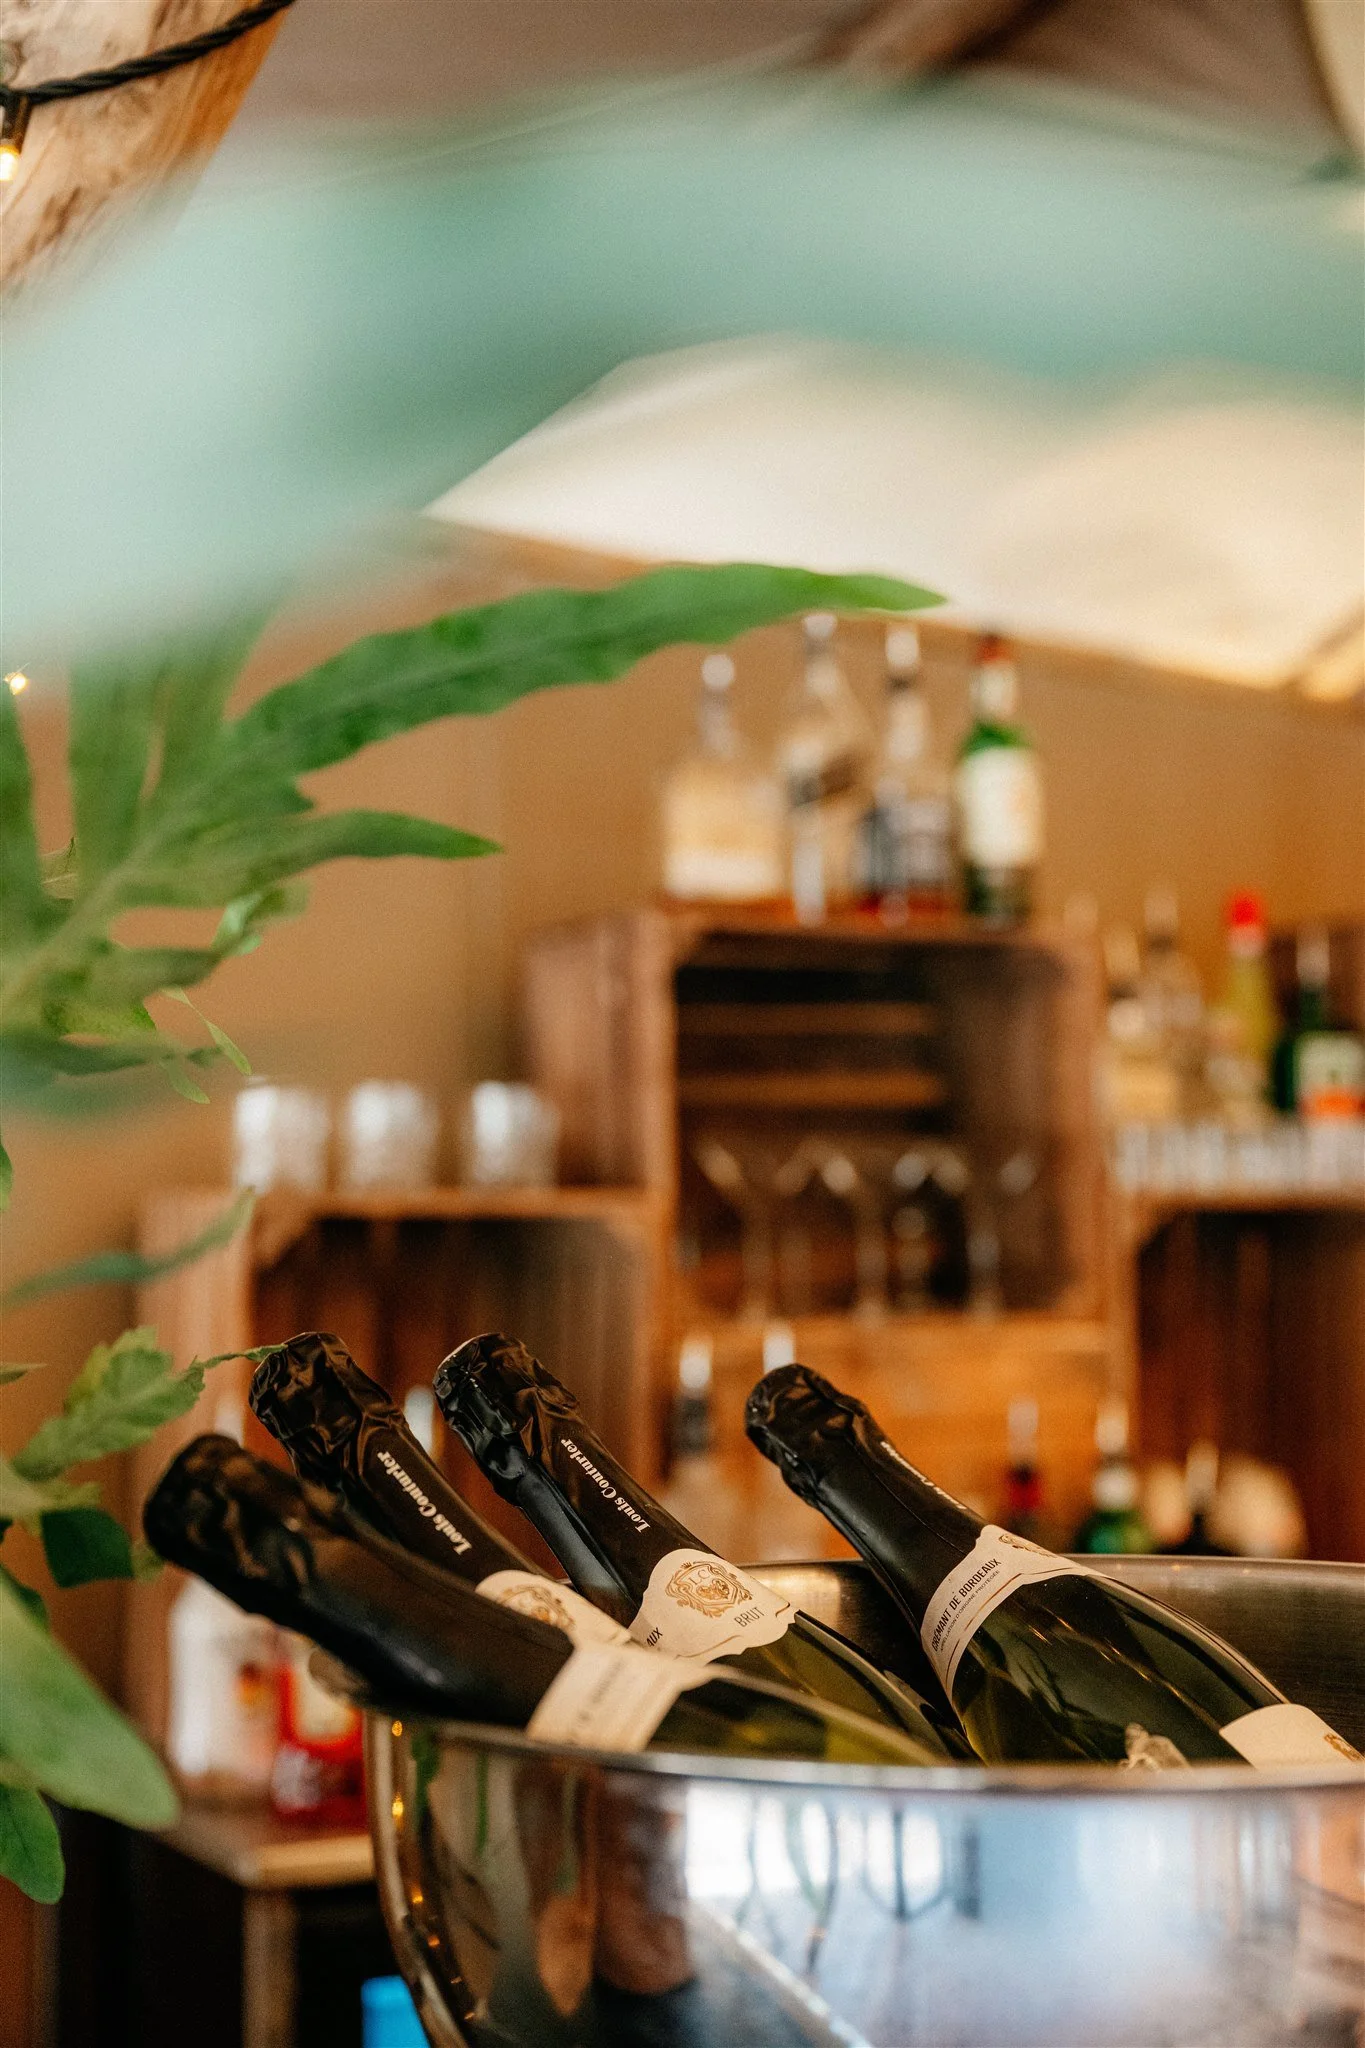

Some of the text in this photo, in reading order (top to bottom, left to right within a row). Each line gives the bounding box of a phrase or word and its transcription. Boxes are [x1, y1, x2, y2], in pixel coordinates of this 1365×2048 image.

[377, 1451, 472, 1555] Louis Couturier
[561, 1439, 650, 1533] Louis Couturier
[734, 1607, 765, 1628] BRUT
[949, 1595, 961, 1611] DE
[958, 1558, 1002, 1598] BORDEAUX
